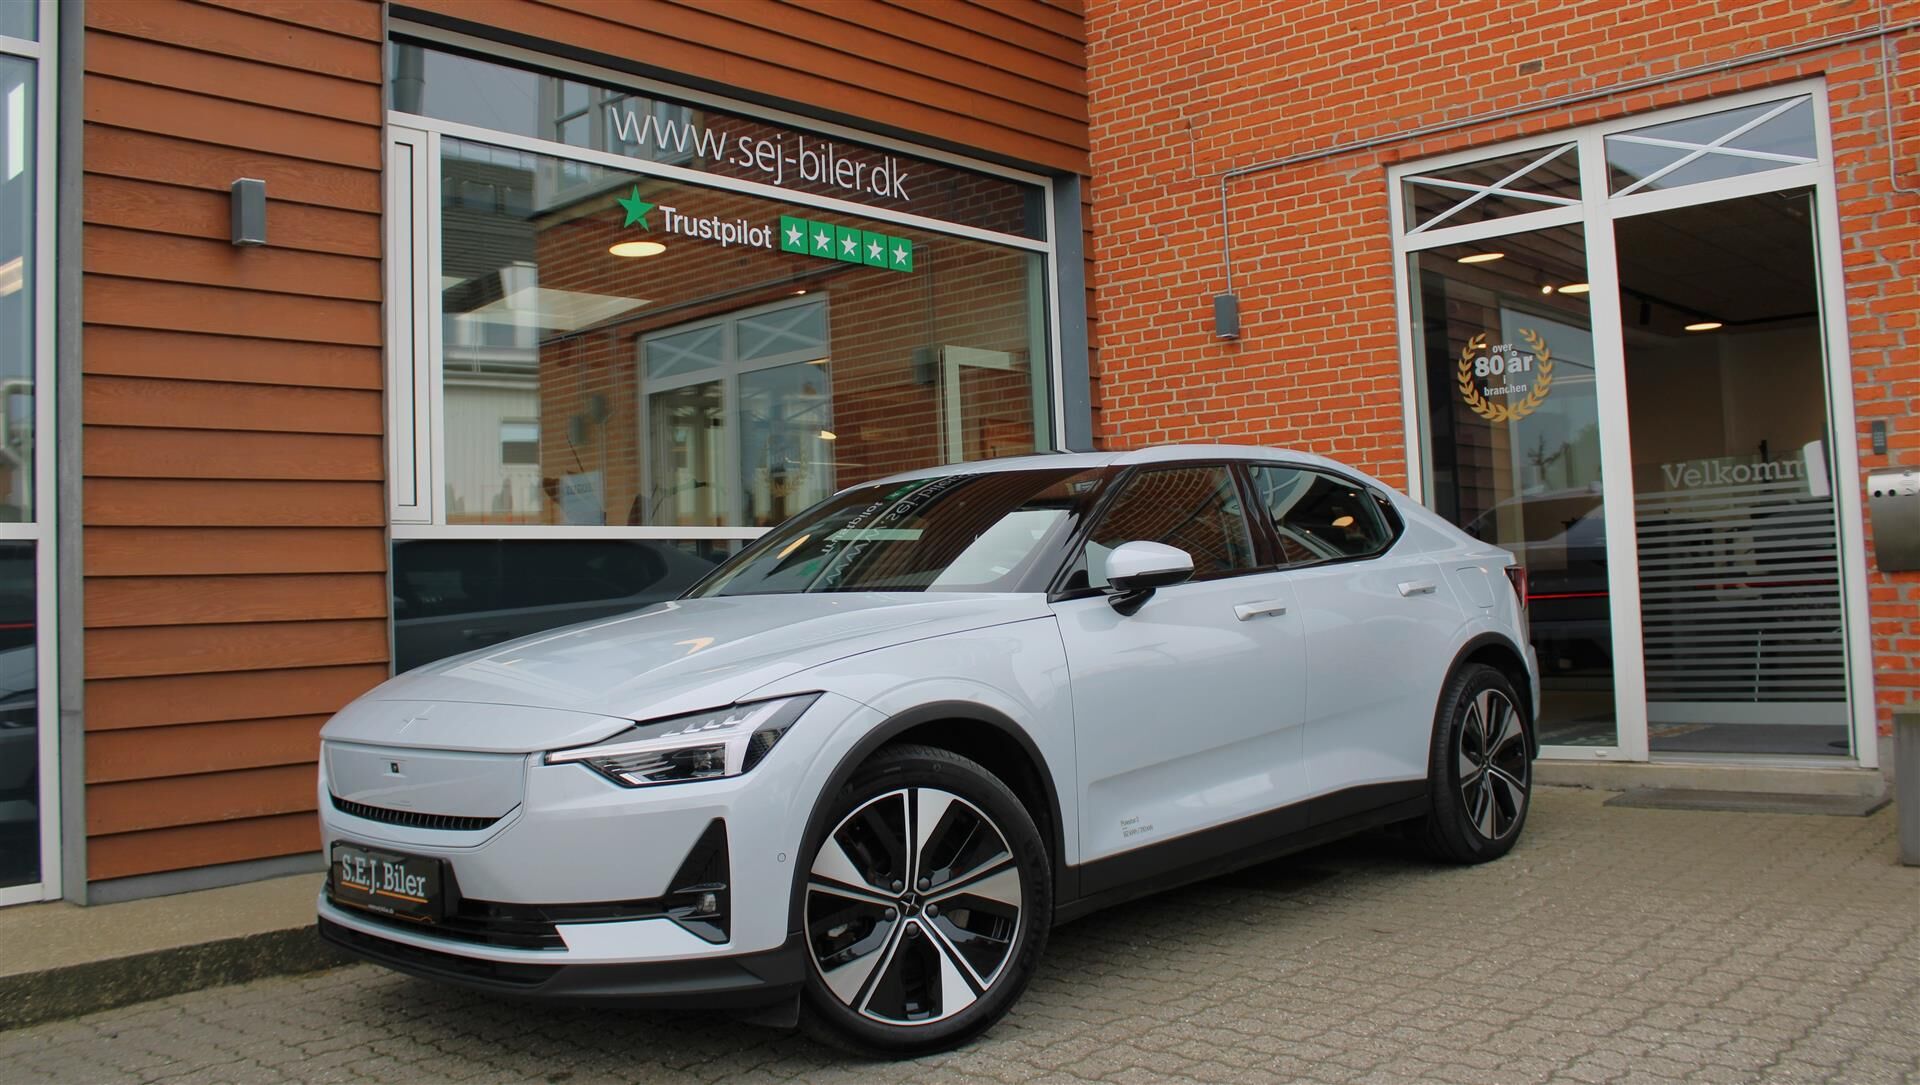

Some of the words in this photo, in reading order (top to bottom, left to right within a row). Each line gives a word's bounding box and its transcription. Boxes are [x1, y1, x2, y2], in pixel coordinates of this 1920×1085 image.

[611, 106, 910, 201] www.sej-biler.dk
[658, 205, 772, 249] Trustpilot
[1474, 354, 1504, 377] 80
[1507, 351, 1533, 373] år
[1492, 343, 1512, 353] over
[1484, 383, 1528, 397] branchen
[342, 854, 380, 894] S.E.J.
[383, 862, 426, 897] Biler
